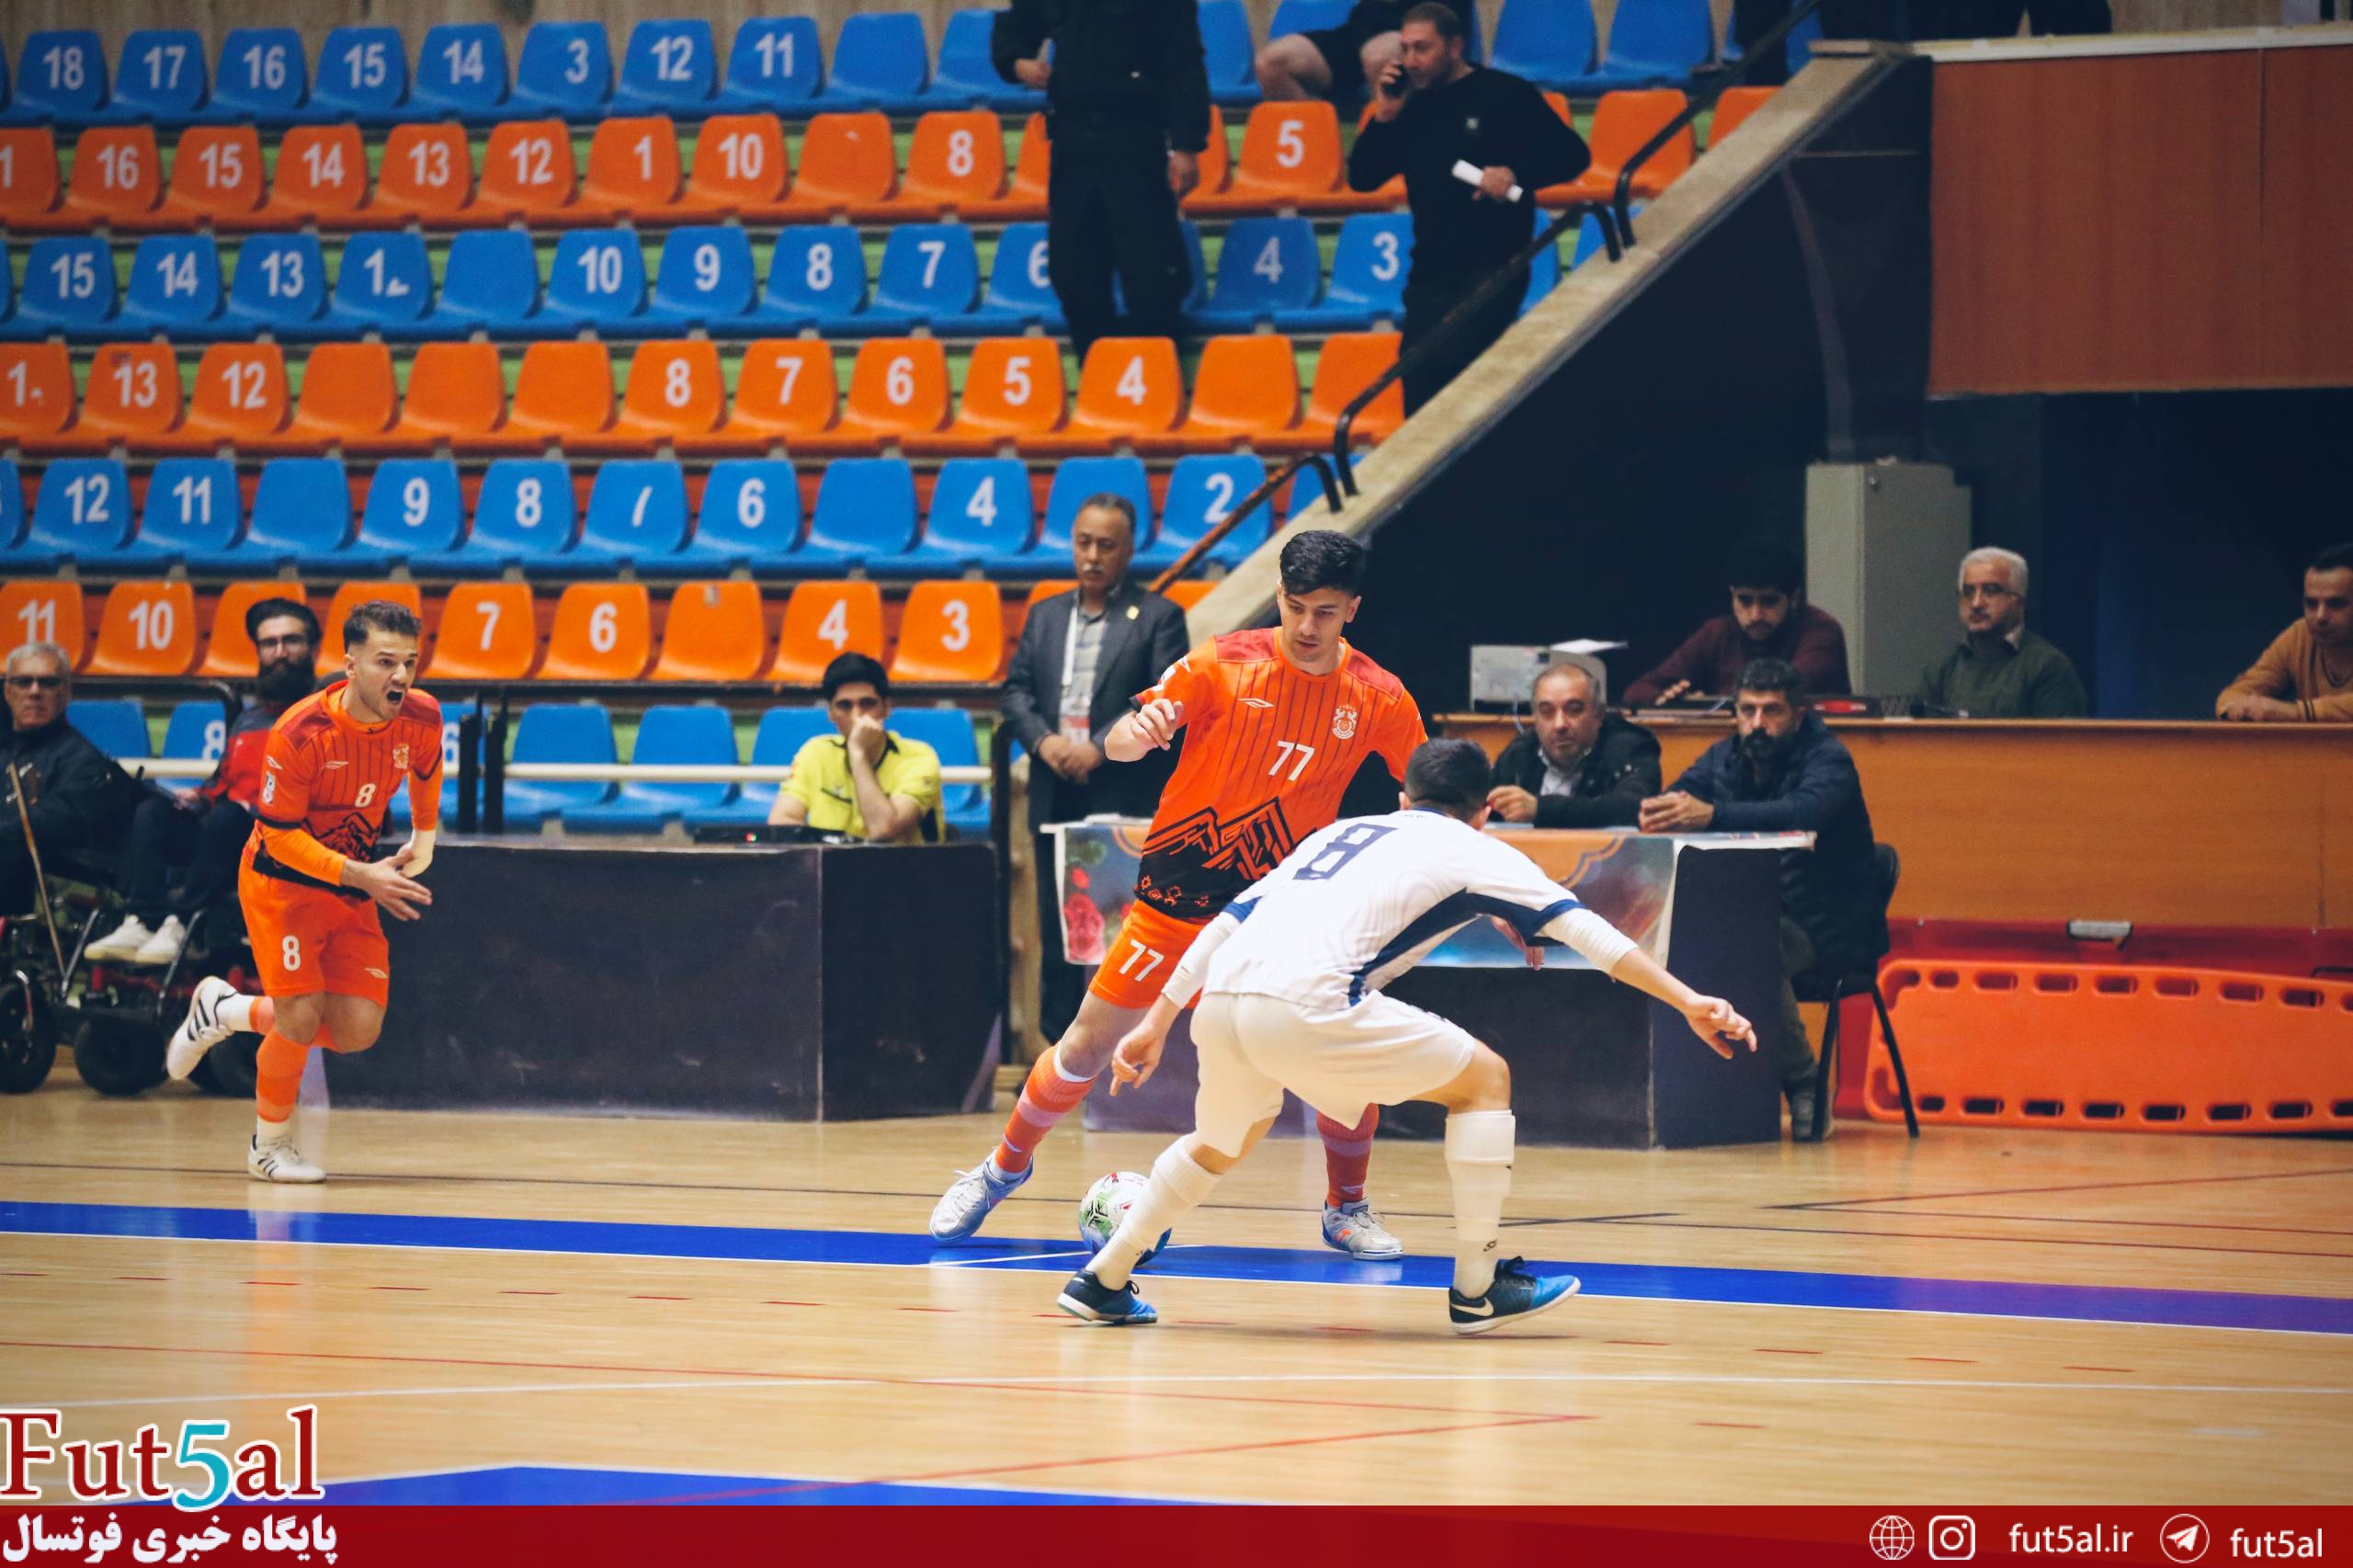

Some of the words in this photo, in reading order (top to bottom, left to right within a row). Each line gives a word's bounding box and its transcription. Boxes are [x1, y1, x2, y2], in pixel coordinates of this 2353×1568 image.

[44, 47, 84, 89] 18
[144, 46, 186, 88] 17
[244, 46, 285, 88] 16
[345, 43, 385, 87] 15
[444, 40, 483, 84] 14
[566, 40, 588, 83] 3
[652, 37, 693, 81] 12
[756, 33, 793, 76] 11
[200, 143, 242, 187] 15
[303, 143, 344, 186] 14
[409, 142, 449, 187] 13
[510, 139, 552, 184] 12
[719, 133, 763, 179] 10
[948, 130, 973, 176] 8
[1278, 120, 1303, 167] 5
[97, 146, 138, 189] 16
[51, 253, 94, 298] 15
[157, 252, 198, 297] 14
[262, 251, 303, 297] 13
[578, 246, 621, 293] 10
[695, 244, 720, 290] 9
[807, 244, 832, 290] 8
[919, 242, 945, 288] 7
[1255, 237, 1282, 282] 4
[1372, 232, 1399, 280] 3
[114, 361, 156, 407] 13
[222, 362, 266, 408] 12
[665, 358, 691, 407] 8
[777, 357, 802, 404] 7
[887, 357, 914, 404] 6
[1004, 357, 1030, 405] 5
[1117, 357, 1147, 404] 4
[65, 474, 108, 523] 12
[174, 477, 210, 523] 11
[404, 478, 429, 526] 9
[516, 479, 541, 528] 8
[738, 479, 765, 528] 6
[967, 477, 996, 526] 4
[1205, 473, 1235, 523] 2
[17, 600, 56, 643] 11
[129, 601, 174, 649] 10
[477, 602, 500, 650] 7
[590, 603, 617, 652] 6
[818, 600, 848, 649] 4
[942, 600, 970, 651] 3
[202, 721, 226, 761] 8
[1268, 740, 1315, 781] 77
[355, 783, 376, 808] 8
[1292, 823, 1398, 881] 8
[281, 935, 301, 971] 8
[1119, 938, 1165, 983] 77
